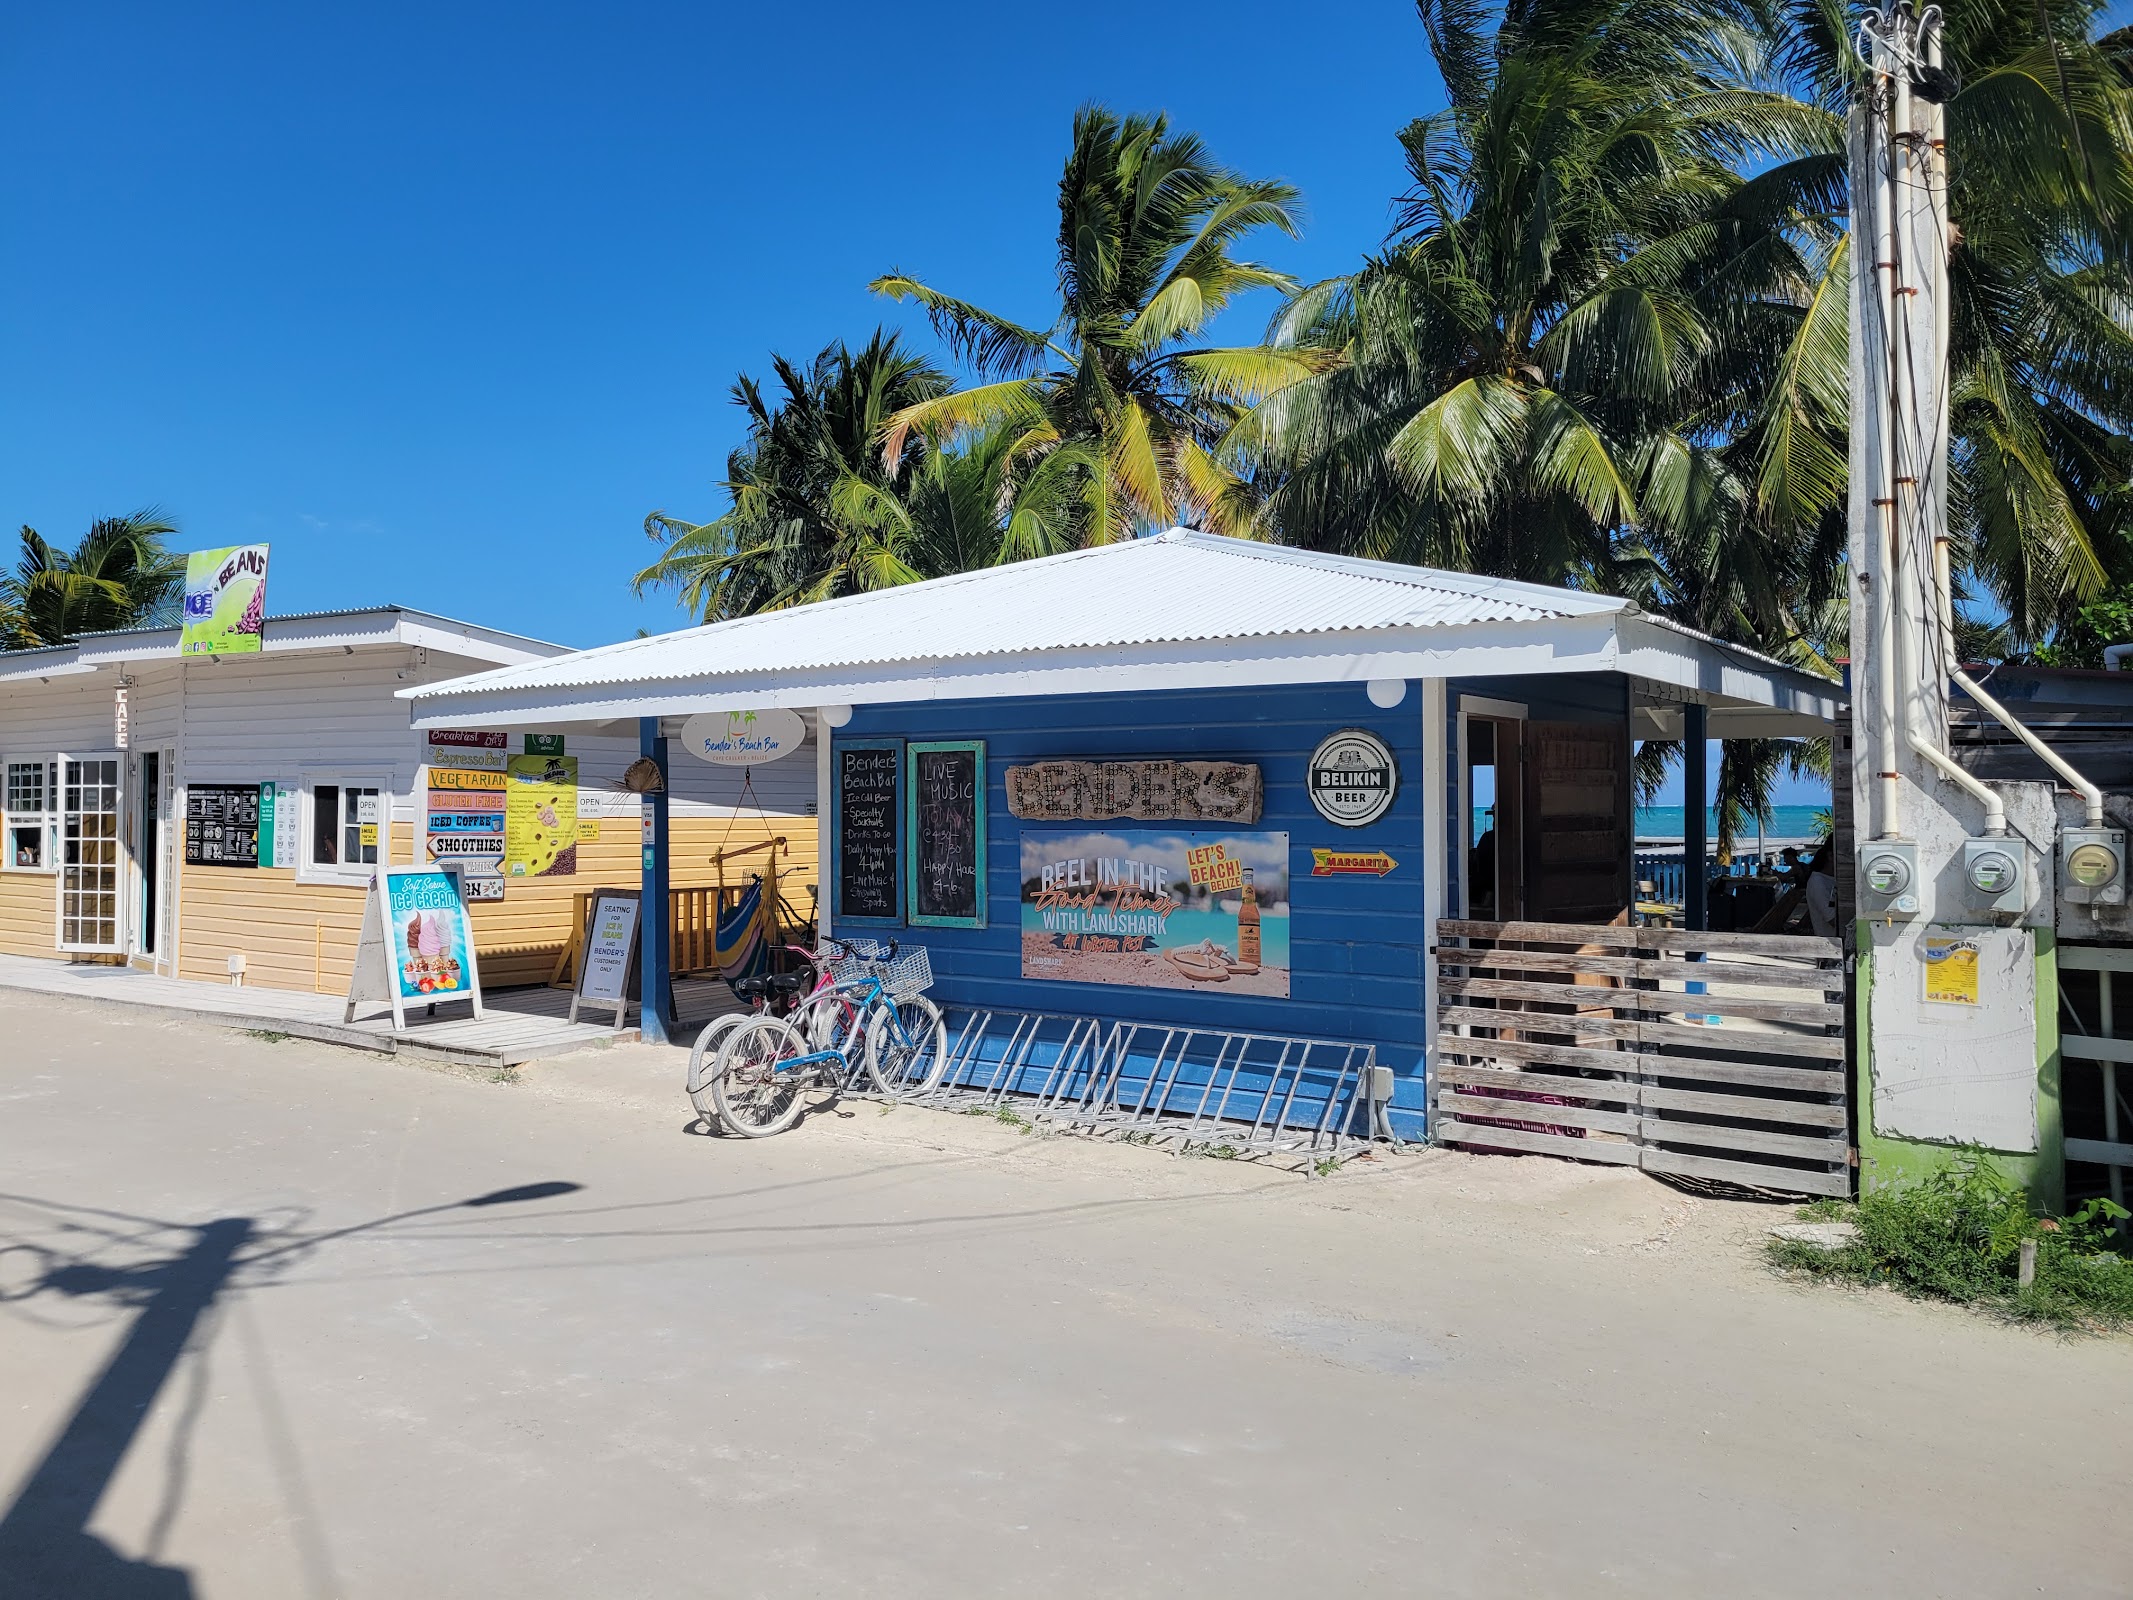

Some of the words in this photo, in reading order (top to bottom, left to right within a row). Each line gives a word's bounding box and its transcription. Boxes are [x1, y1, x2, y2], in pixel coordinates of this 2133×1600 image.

[184, 591, 212, 619] ICE
[219, 550, 265, 589] BEANS
[431, 730, 479, 742] Breakfast
[484, 737, 504, 747] DAY
[704, 736, 737, 754] Bender's
[739, 737, 762, 753] Beach
[764, 736, 780, 752] Bar
[435, 747, 484, 767] Espresso
[485, 750, 503, 766] Bar
[846, 751, 896, 772] Bender's
[924, 760, 958, 781] LIVE
[1320, 771, 1381, 787] BELIKIN
[430, 771, 506, 789] VEGETARIAN
[844, 773, 876, 790] Beach
[877, 772, 896, 788] Bar
[931, 782, 973, 800] MUSIC
[1014, 763, 1249, 818] BENDER'S
[1335, 792, 1366, 803] BEER
[360, 801, 377, 809] OPEN
[432, 794, 473, 807] GLUTEN
[475, 795, 503, 809] FREE
[580, 798, 600, 806] OPEN
[431, 816, 452, 827] ICED
[456, 816, 492, 827] COFFEE
[436, 838, 503, 852] SMOOTHIES
[1187, 844, 1226, 866] LET'S
[1326, 857, 1389, 868] MARGARITA
[1041, 858, 1092, 893] REEL
[1097, 857, 1119, 886] IN
[1124, 859, 1168, 898] THE
[1190, 860, 1241, 884] BEACH!
[402, 877, 421, 892] Soft
[421, 877, 447, 892] Serve
[1210, 876, 1242, 892] BELIZE
[390, 891, 413, 911] ICE
[1030, 879, 1104, 920] Good
[1108, 879, 1182, 919] Times
[604, 905, 631, 914] SEATING
[1042, 911, 1079, 931] WITH
[1081, 911, 1168, 936] LANDSHARK
[1062, 931, 1080, 950] AT
[594, 947, 625, 957] BENDER'S
[594, 957, 622, 966] CUSTOMERS
